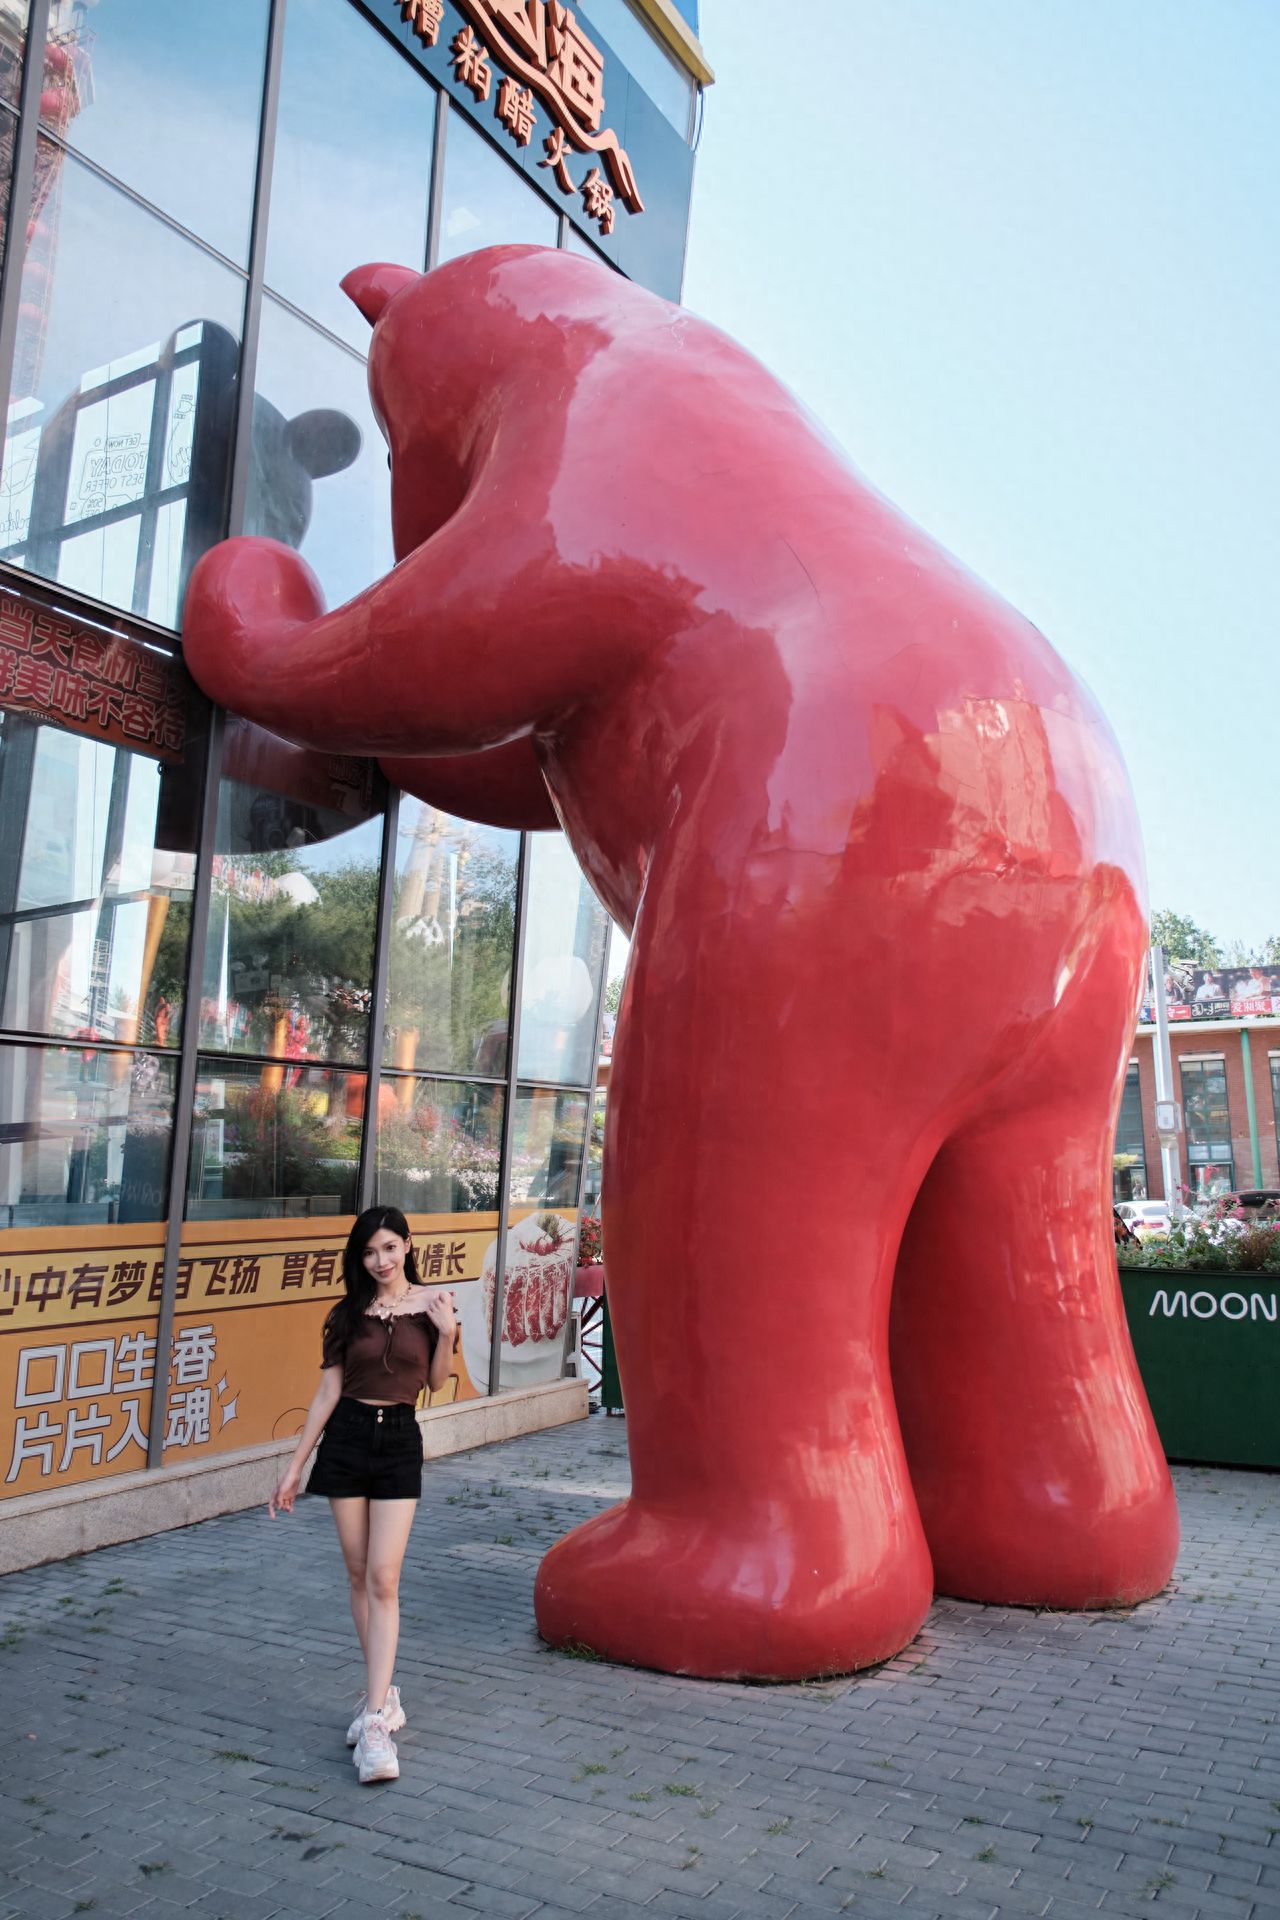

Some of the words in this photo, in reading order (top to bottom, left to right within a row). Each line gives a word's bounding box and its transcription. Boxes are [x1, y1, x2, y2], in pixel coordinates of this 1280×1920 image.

[1148, 1289, 1278, 1322] MOON
[14, 1323, 217, 1410] 口口生香
[4, 1386, 213, 1484] 片片入魂
